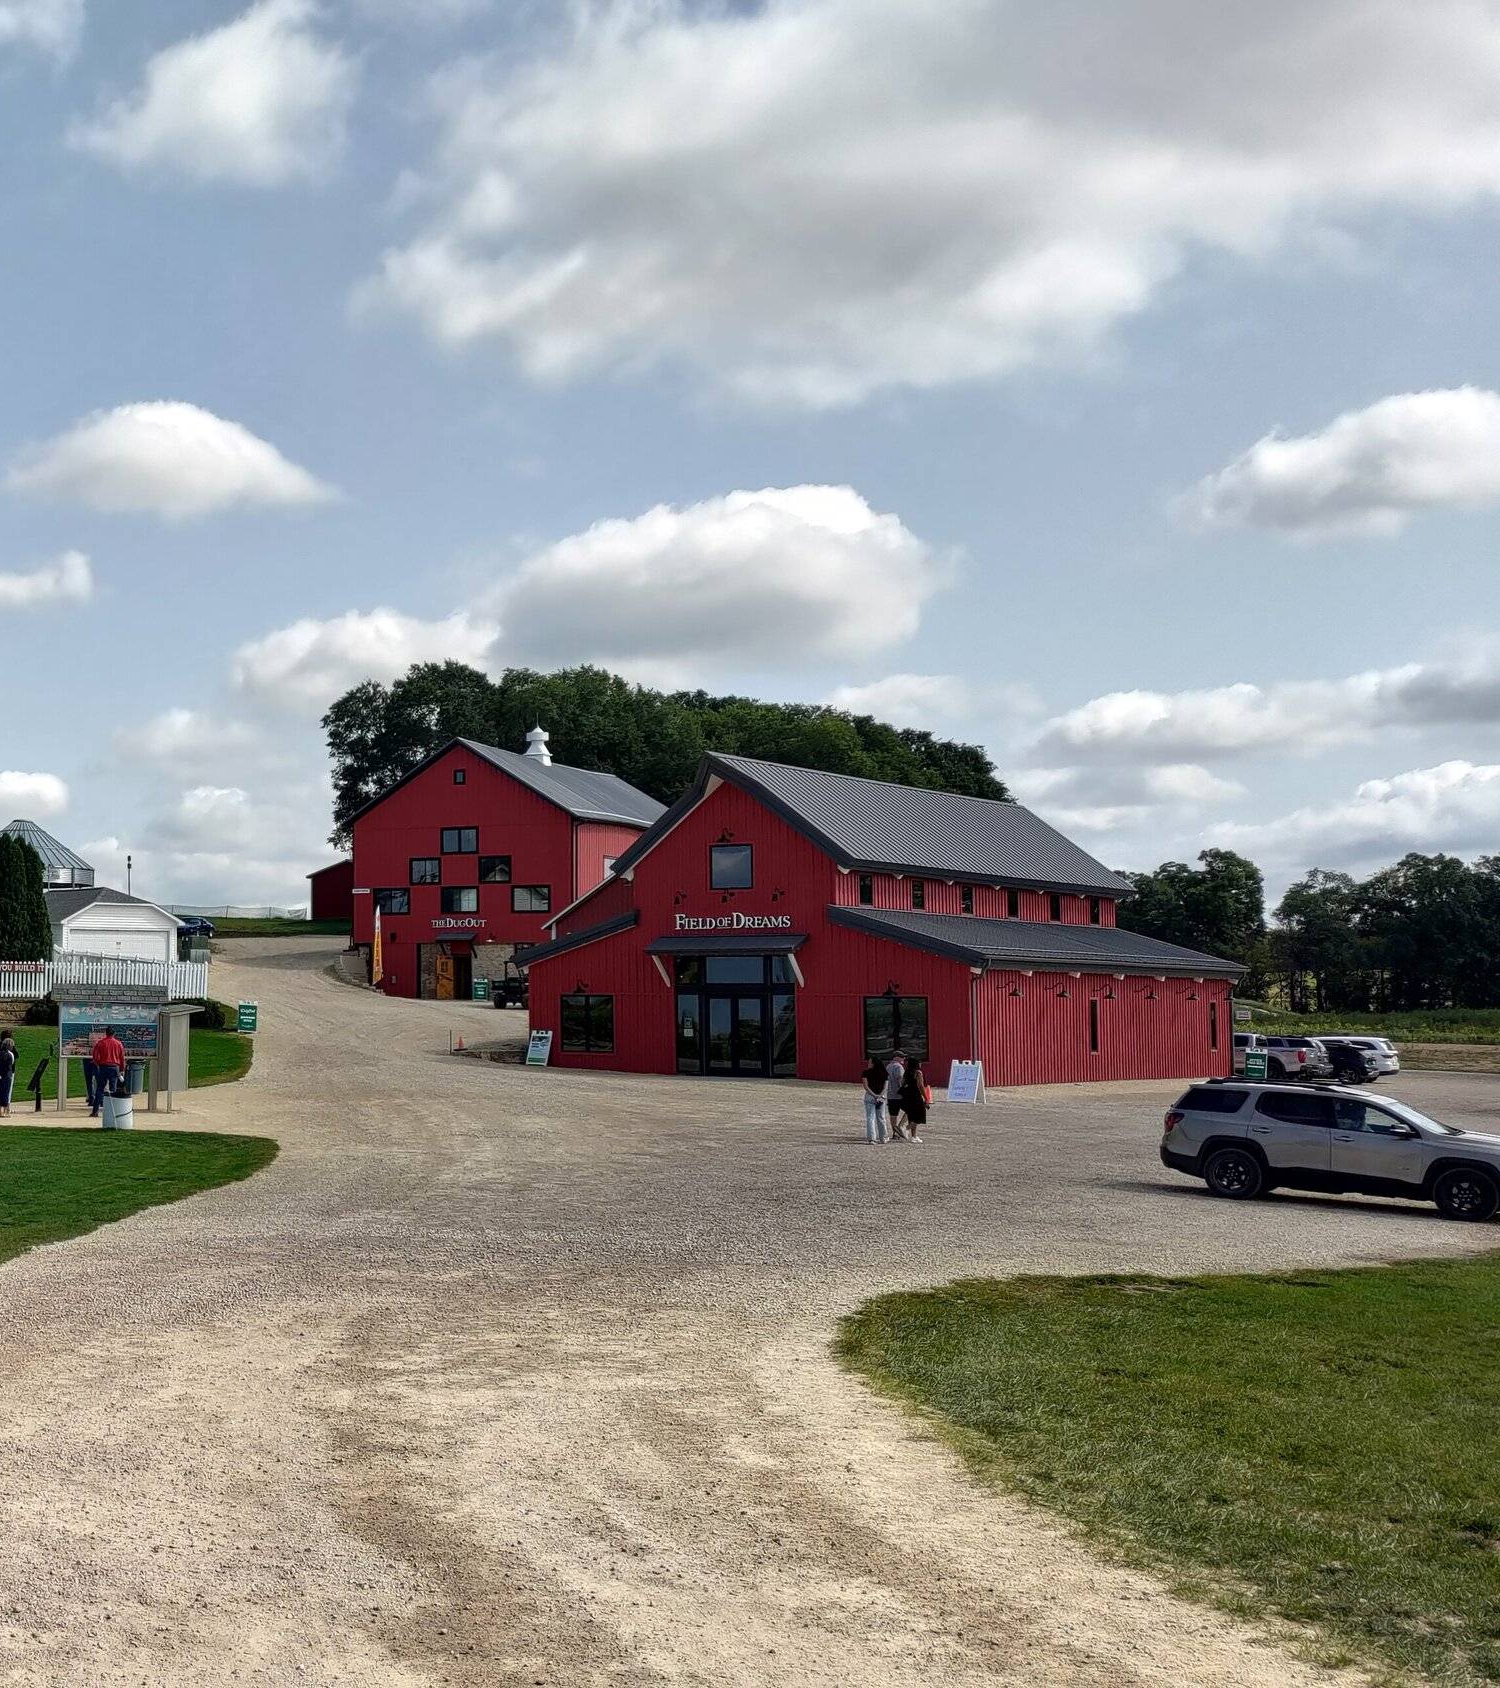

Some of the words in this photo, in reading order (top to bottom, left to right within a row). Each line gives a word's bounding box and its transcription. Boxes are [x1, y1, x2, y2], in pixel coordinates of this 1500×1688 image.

[675, 914, 715, 929] FIELD
[717, 917, 731, 928] OF
[732, 912, 791, 928] DREAMS
